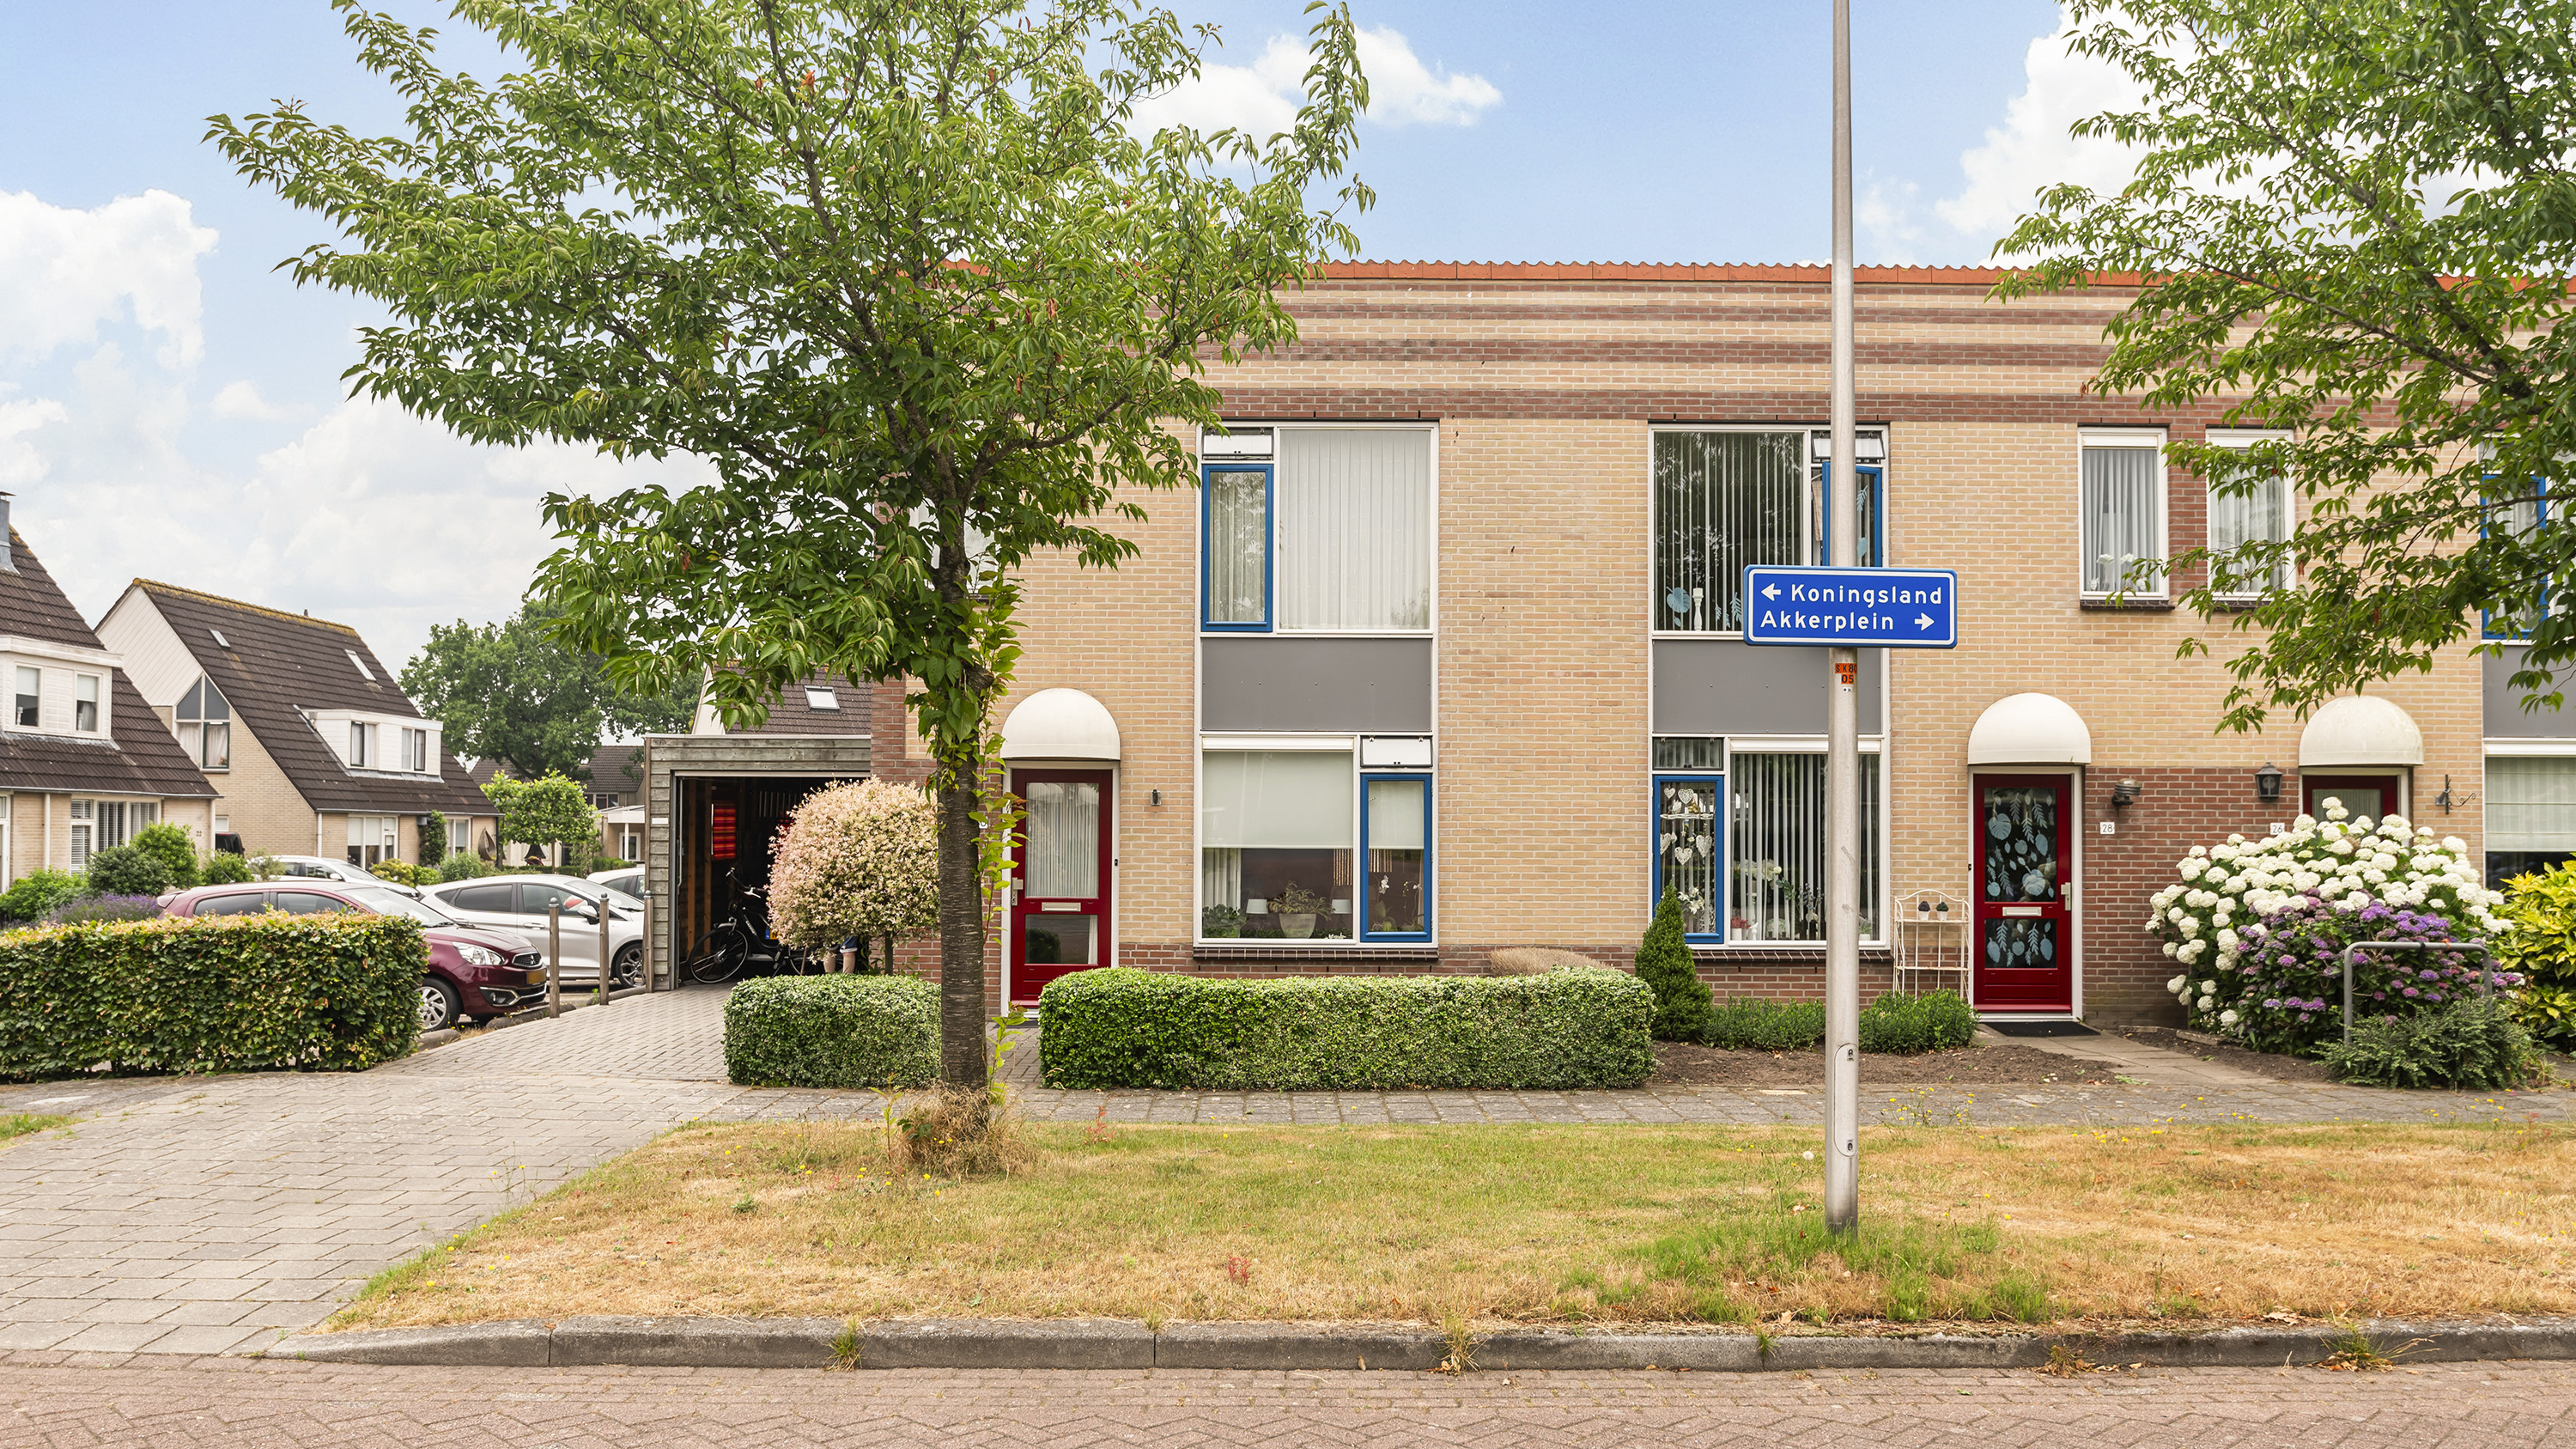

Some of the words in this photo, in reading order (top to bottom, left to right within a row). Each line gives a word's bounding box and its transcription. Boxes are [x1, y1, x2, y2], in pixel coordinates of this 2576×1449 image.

[1791, 583, 1941, 609] Koningsland
[1760, 610, 1893, 633] Akkerplein
[1841, 674, 1854, 684] 05
[2102, 824, 2113, 833] 28
[2272, 825, 2283, 834] 26
